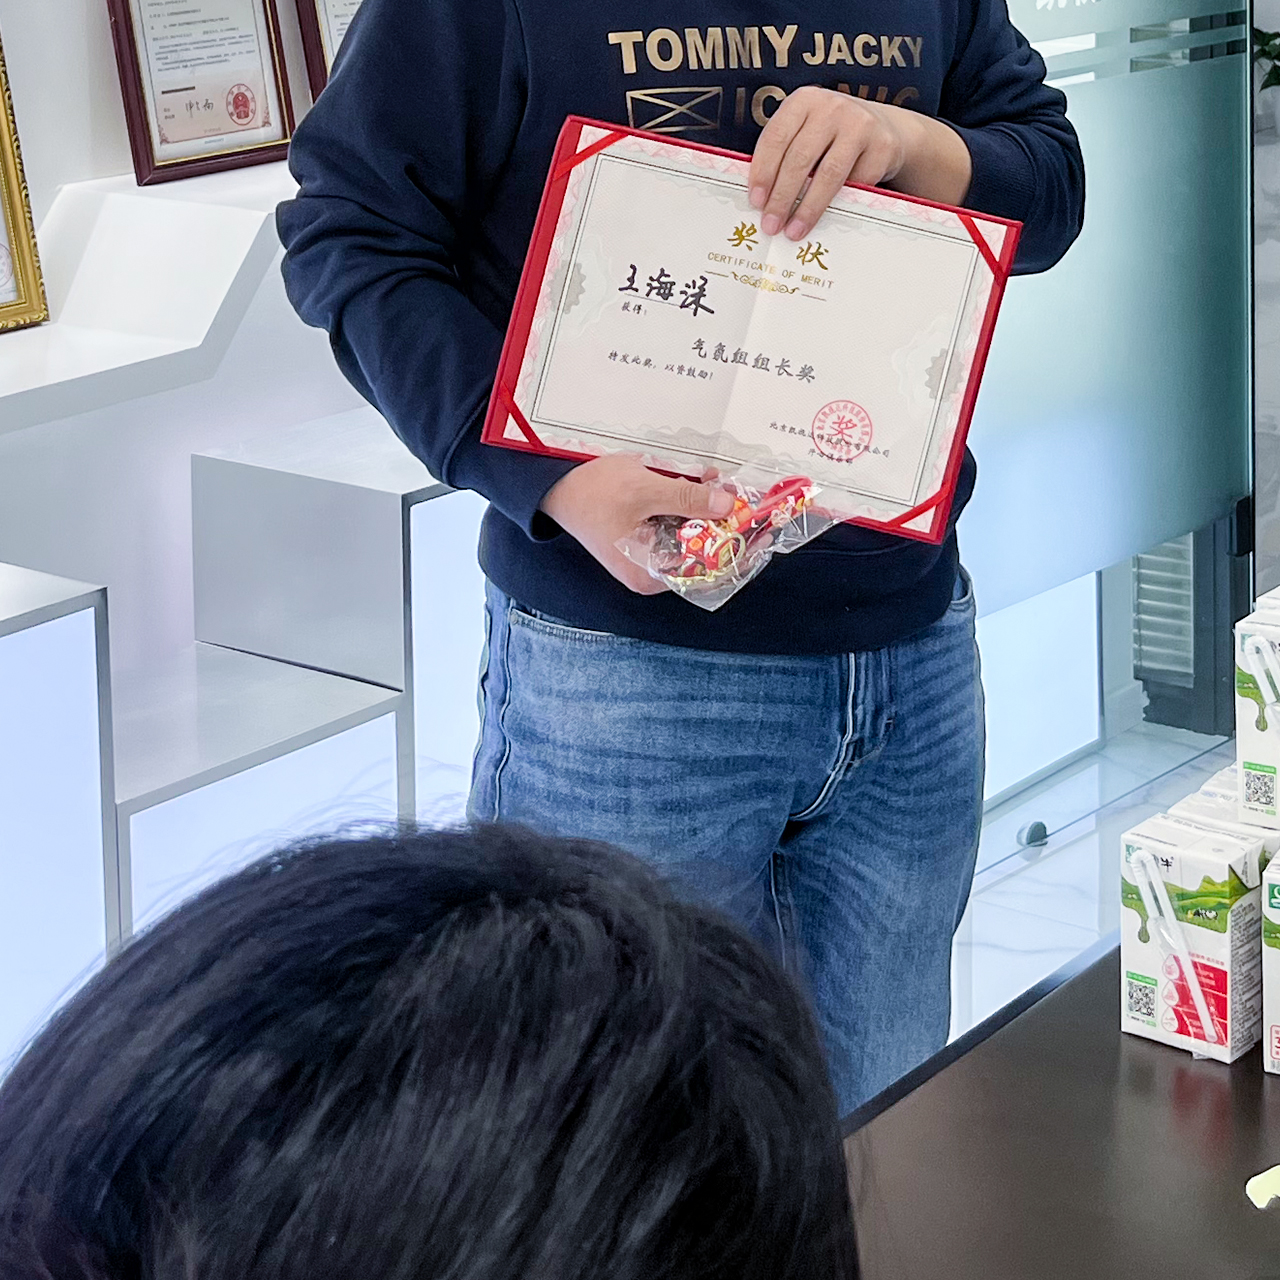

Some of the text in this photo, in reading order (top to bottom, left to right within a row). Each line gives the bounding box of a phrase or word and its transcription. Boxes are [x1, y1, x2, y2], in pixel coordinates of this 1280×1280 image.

[608, 24, 923, 75] TOMMY JACKY
[727, 221, 829, 271] 奖状
[707, 251, 835, 290] CERTIFICATE OF MERIT
[691, 337, 816, 384] 气氛组组长奖
